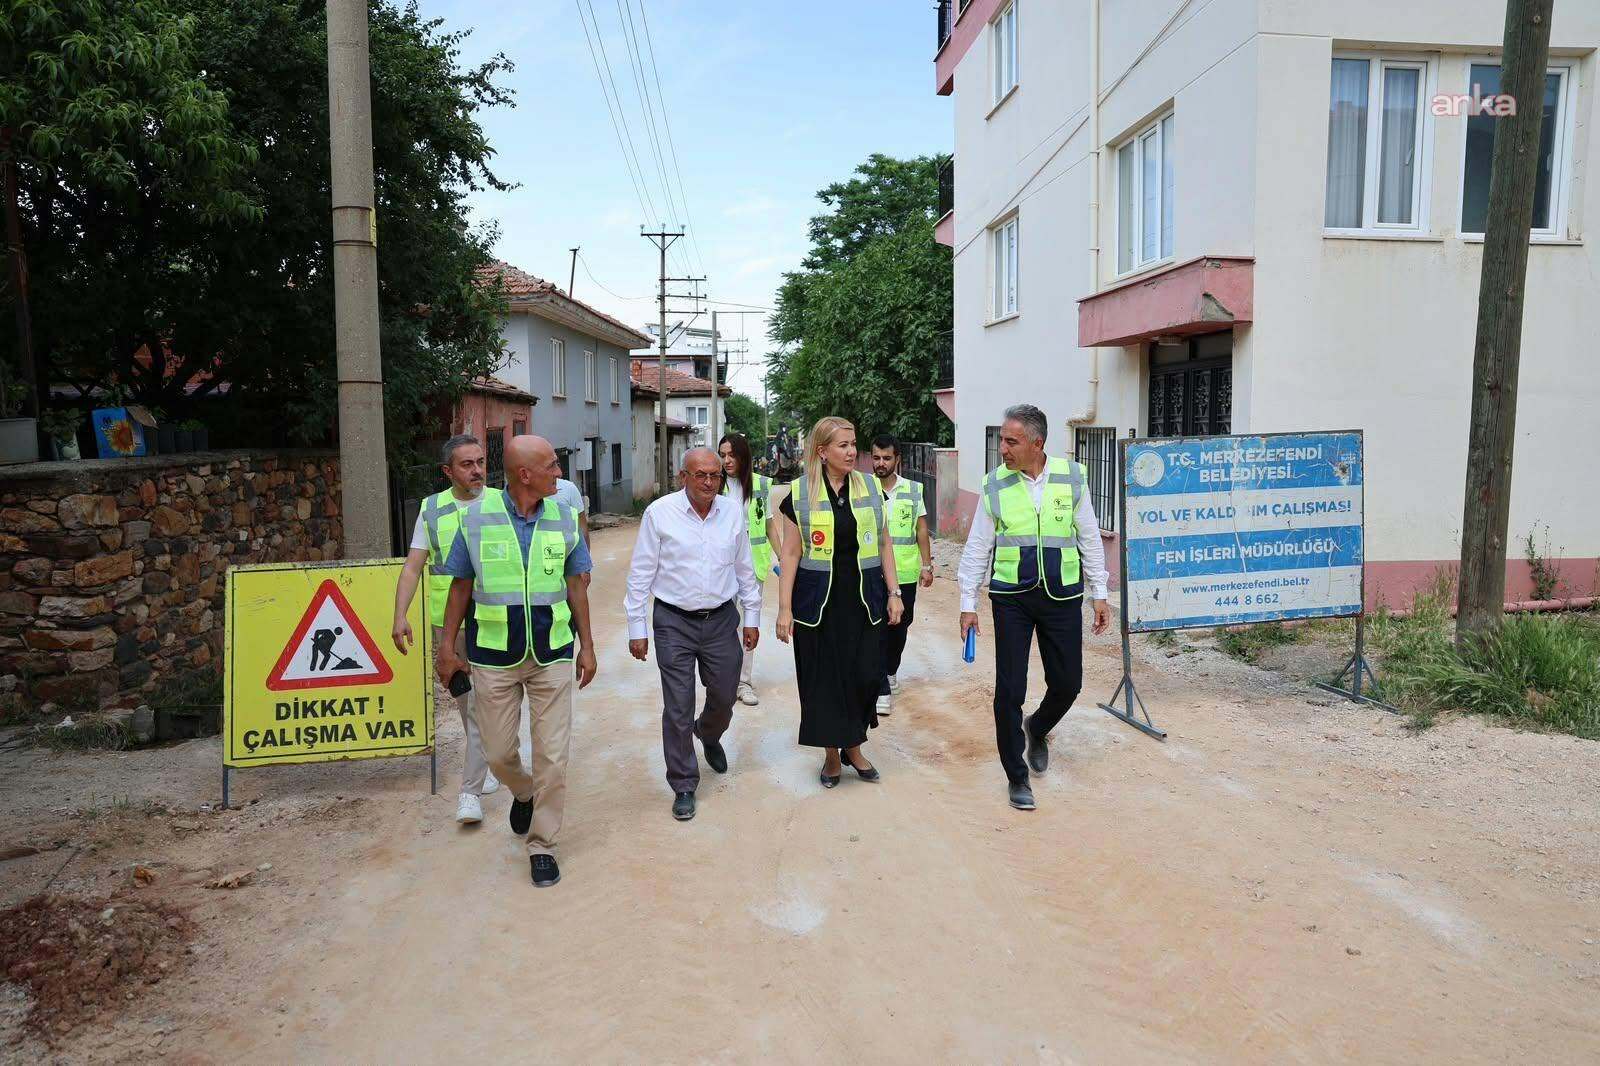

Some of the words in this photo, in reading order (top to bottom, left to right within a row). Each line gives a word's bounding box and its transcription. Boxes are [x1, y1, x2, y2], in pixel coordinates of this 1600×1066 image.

[1200, 444, 1322, 465] MERKEZEFENDİ
[1199, 463, 1292, 483] BELEDİYESİ
[1138, 509, 1167, 524] YOL
[1171, 508, 1191, 522] VE
[1195, 504, 1268, 521] KALDIM
[1156, 550, 1186, 565] FEN
[1190, 544, 1236, 565] İŞLERİ
[1240, 537, 1334, 558] MÜDÜRLÜĞÜ
[1182, 576, 1310, 595] www.merkezefendi.bel.tr
[1215, 596, 1239, 607] 444
[1245, 595, 1252, 606] 8
[1256, 593, 1279, 605] 662
[275, 697, 370, 721] DİKKAT
[378, 696, 384, 714] !
[243, 723, 358, 754] ÇALIŞMA
[365, 719, 416, 740] VAR
